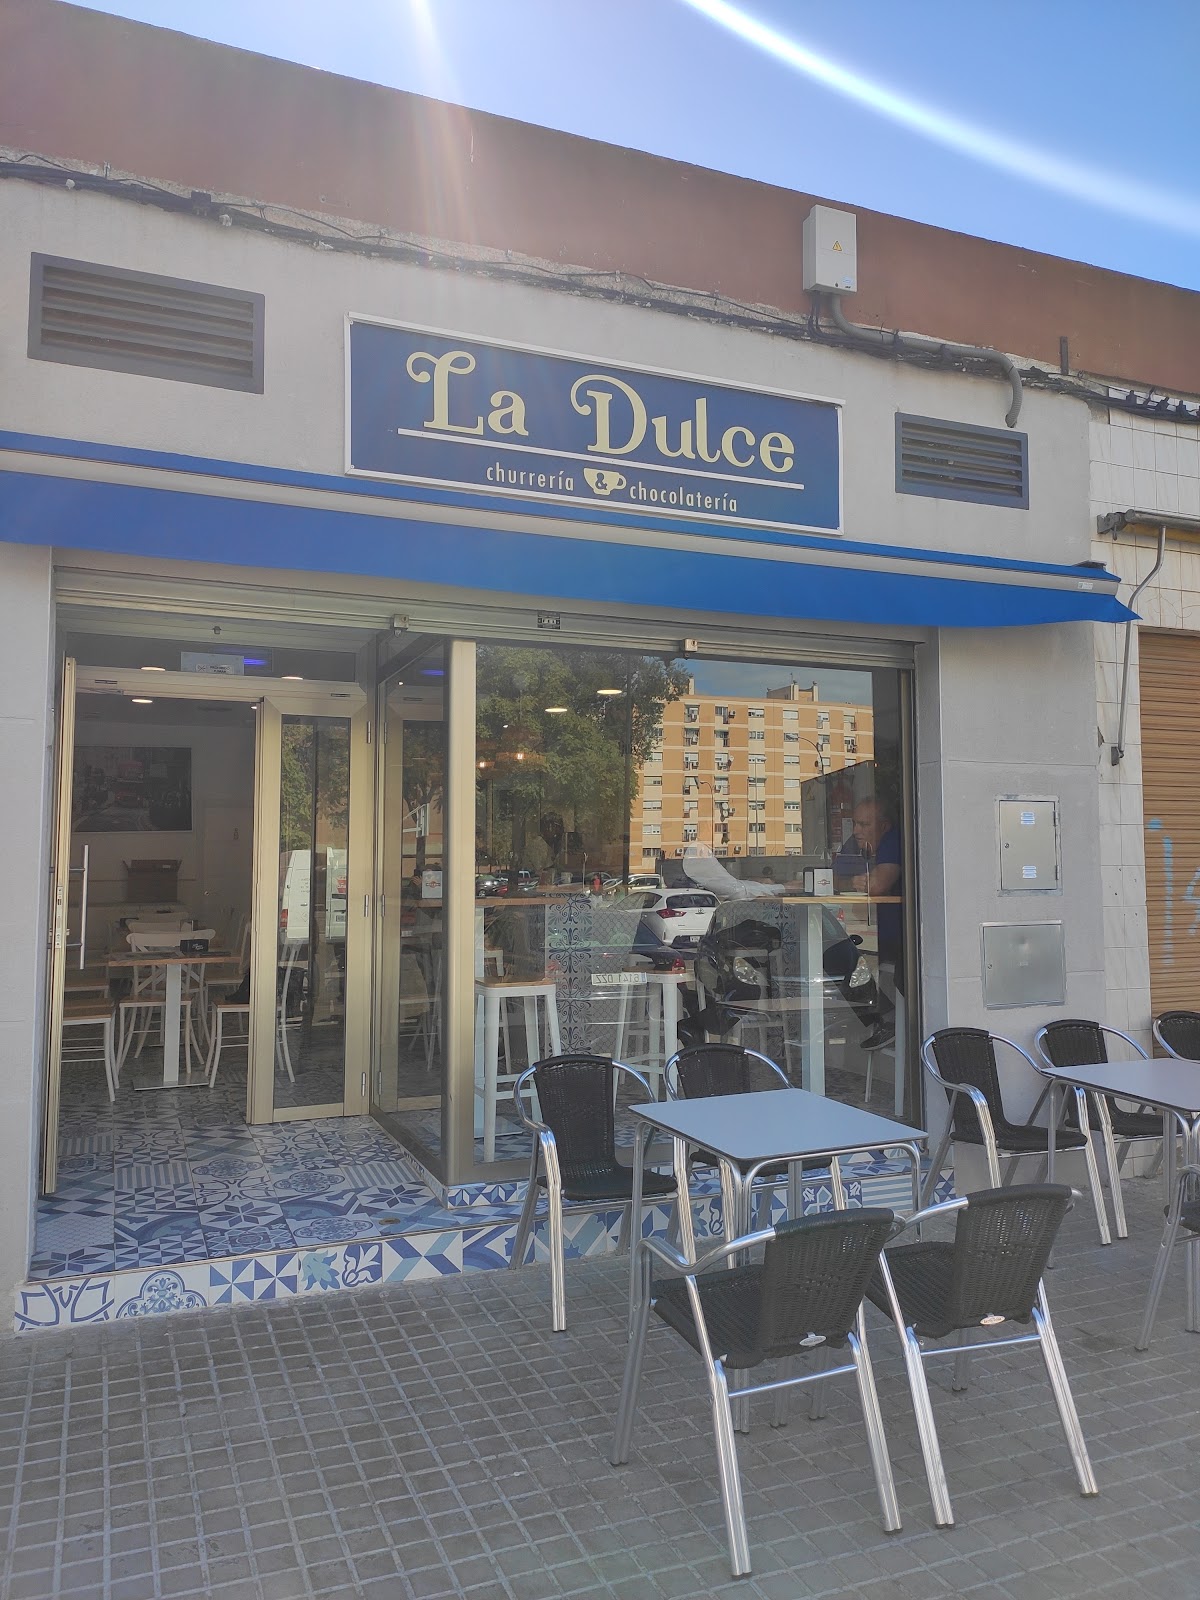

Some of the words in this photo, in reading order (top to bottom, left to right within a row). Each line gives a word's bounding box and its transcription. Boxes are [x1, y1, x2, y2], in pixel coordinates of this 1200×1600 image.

[407, 351, 529, 437] La
[570, 374, 795, 473] Dulce
[486, 462, 574, 492] churrería
[629, 483, 737, 512] chocolatería
